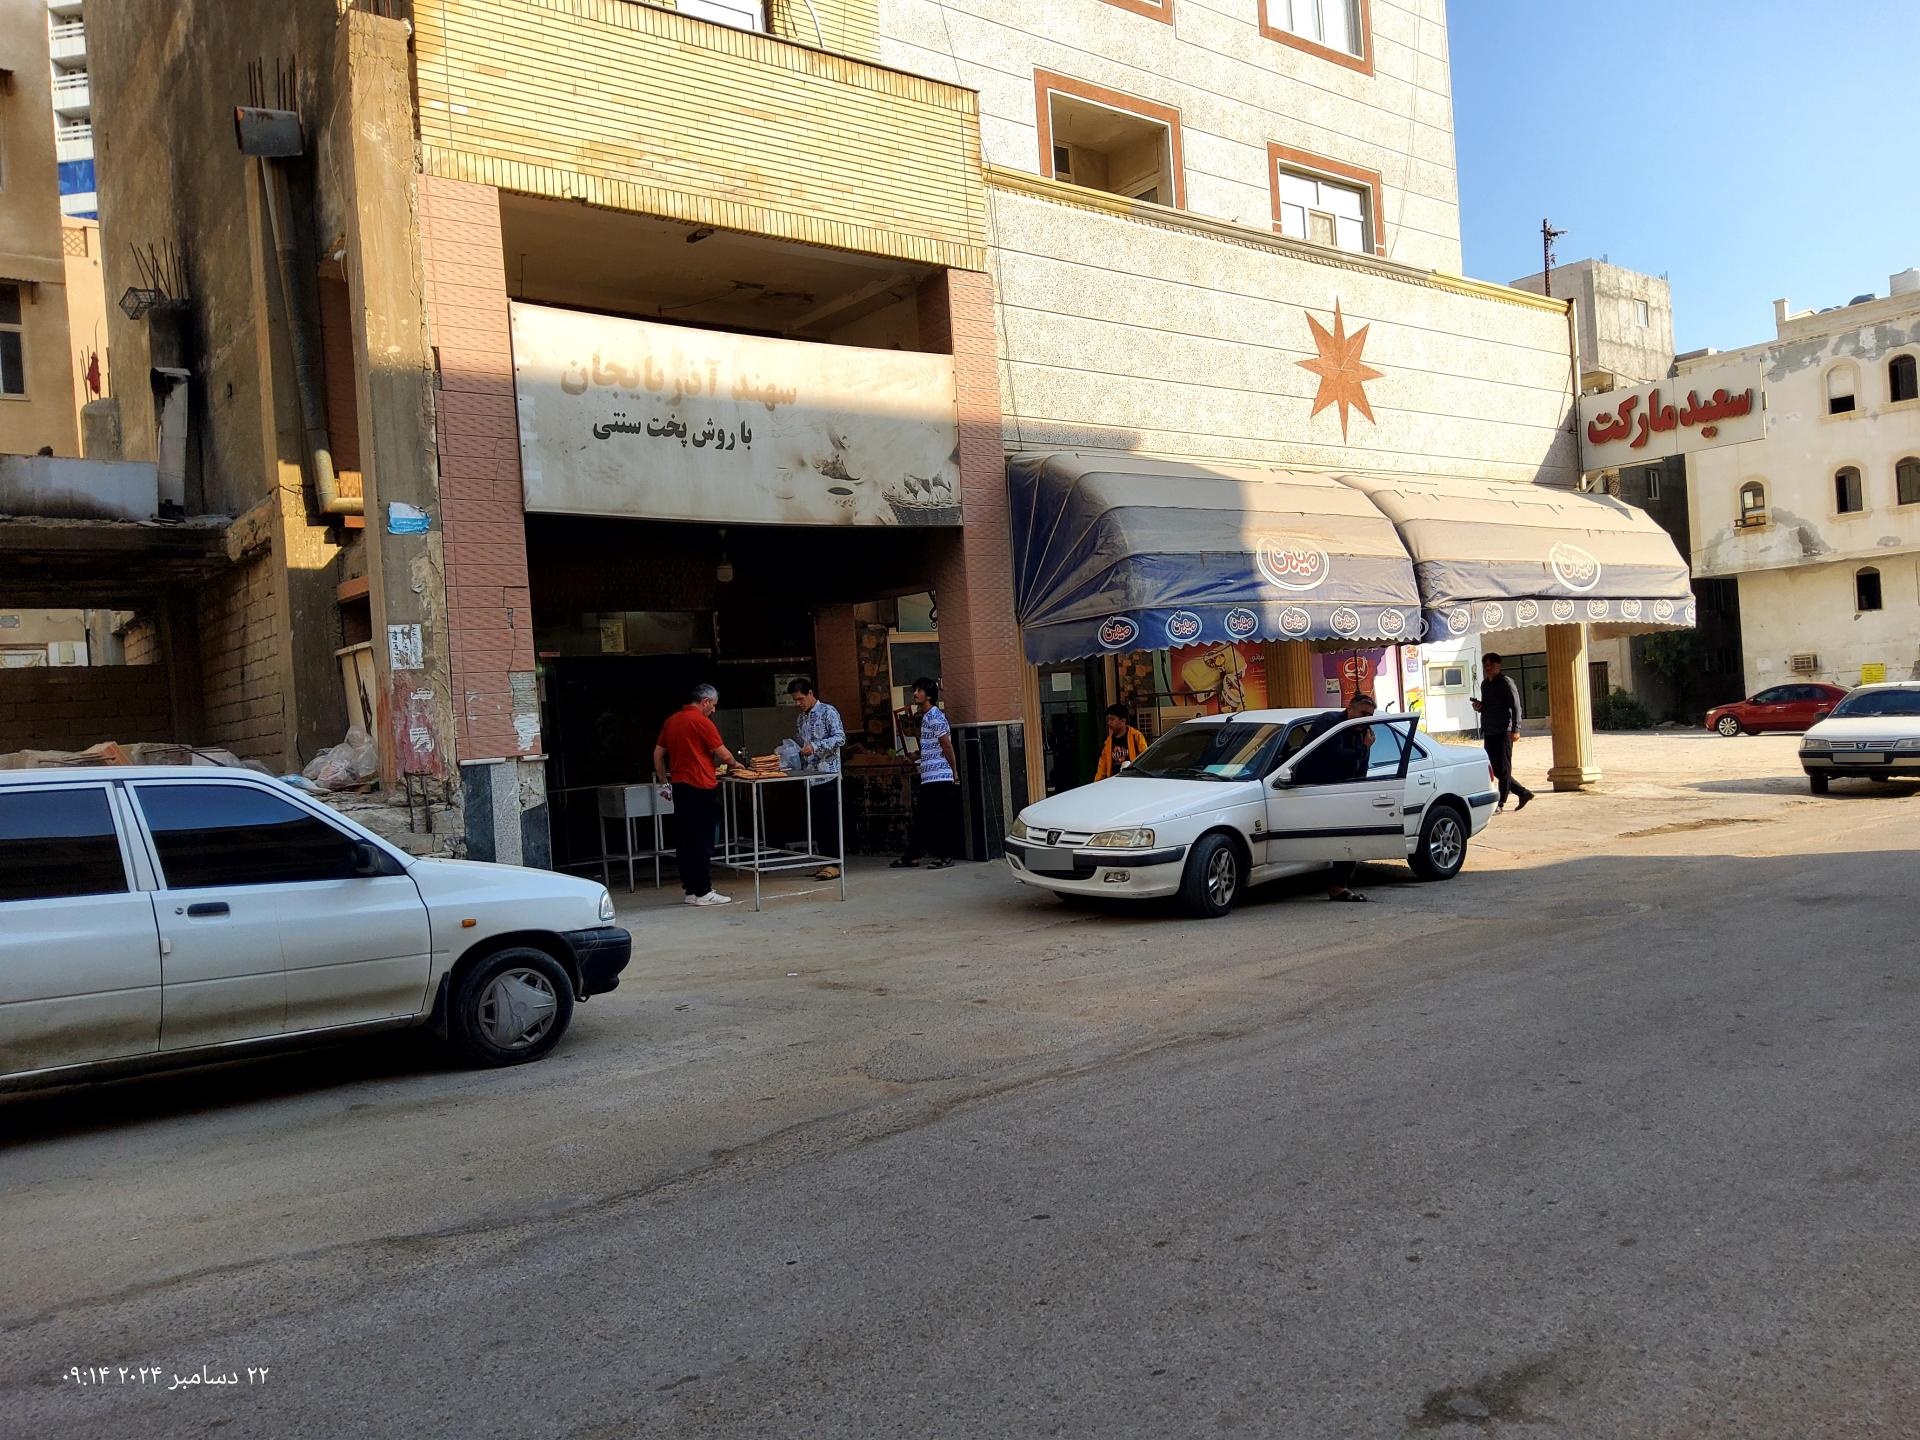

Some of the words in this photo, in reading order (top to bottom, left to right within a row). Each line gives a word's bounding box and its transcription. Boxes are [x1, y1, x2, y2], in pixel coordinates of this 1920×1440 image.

[593, 412, 641, 440] سنتی
[647, 414, 688, 448] پخت
[692, 418, 736, 451] روش
